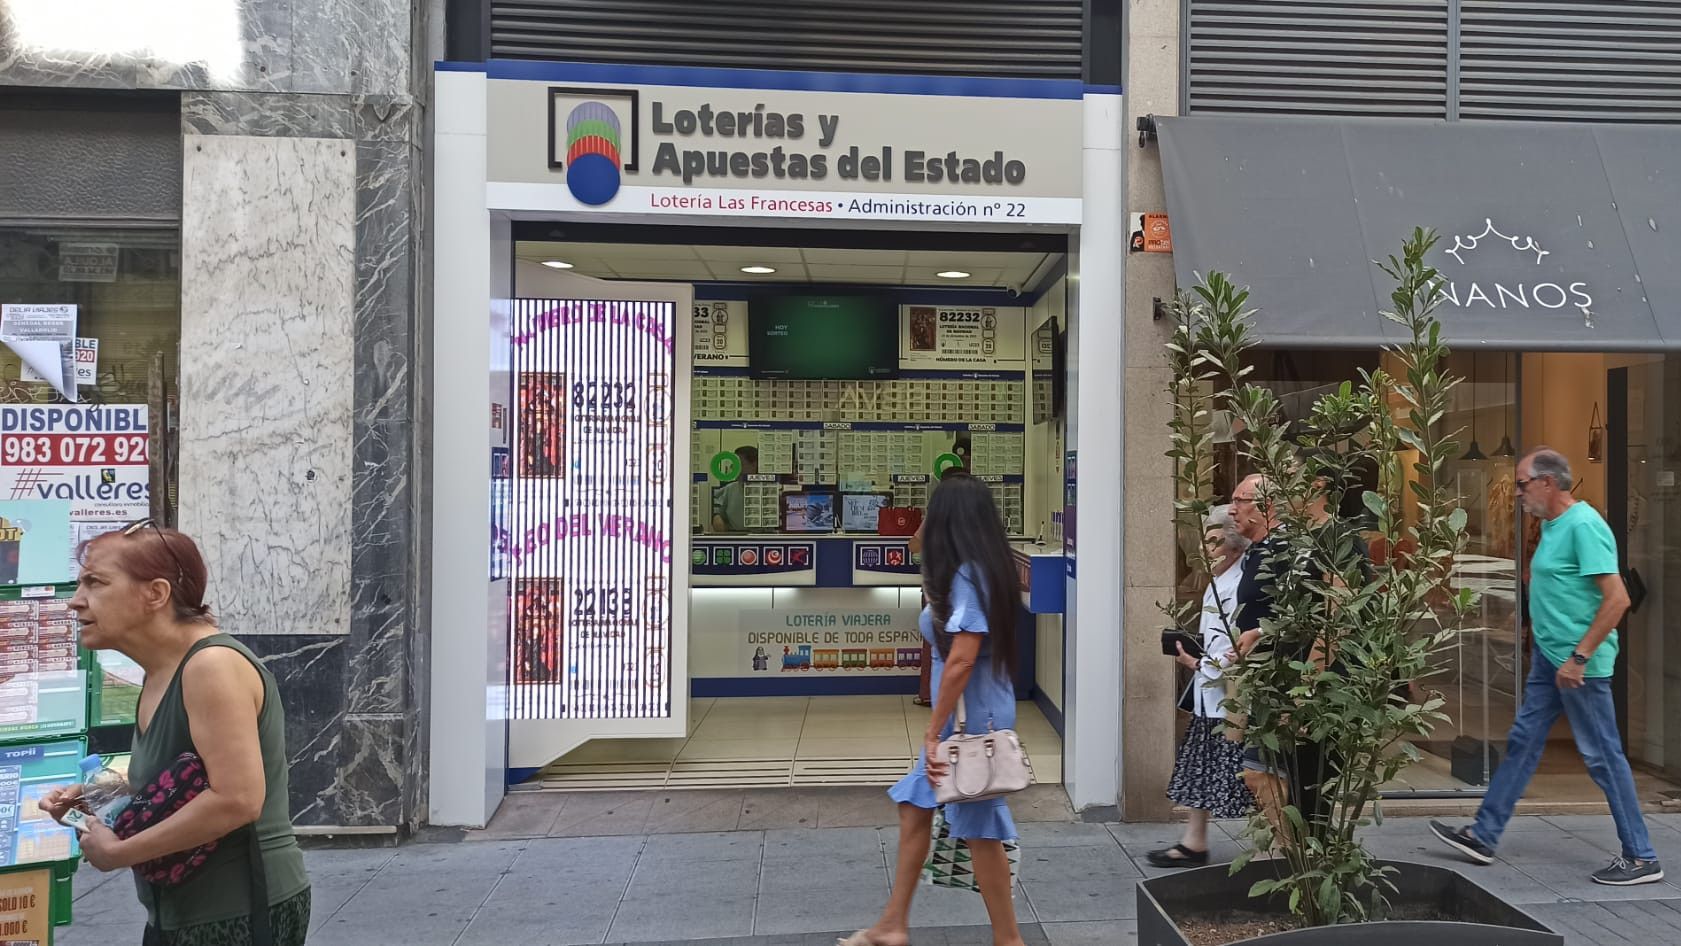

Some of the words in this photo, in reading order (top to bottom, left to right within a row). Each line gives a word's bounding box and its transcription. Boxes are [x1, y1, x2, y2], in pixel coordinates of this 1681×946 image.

[651, 101, 805, 138] Loterías
[817, 112, 840, 147] y
[652, 142, 828, 185] Apuestas
[836, 146, 892, 181] del
[905, 150, 1026, 186] Estado
[650, 193, 714, 209] Lotería
[718, 194, 745, 210] Las
[750, 196, 833, 213] Francesas
[848, 199, 976, 217] Administración
[1005, 203, 1026, 218] 22
[939, 311, 980, 323] 82232
[76, 367, 92, 377] es
[573, 381, 635, 409] 82232
[5, 436, 52, 463] 983
[59, 436, 106, 463] 072
[113, 436, 150, 463] 92
[785, 612, 836, 627] LOTERÍA
[748, 631, 819, 644] DISPONIBLE
[824, 631, 839, 644] DE
[844, 631, 873, 643] TODA
